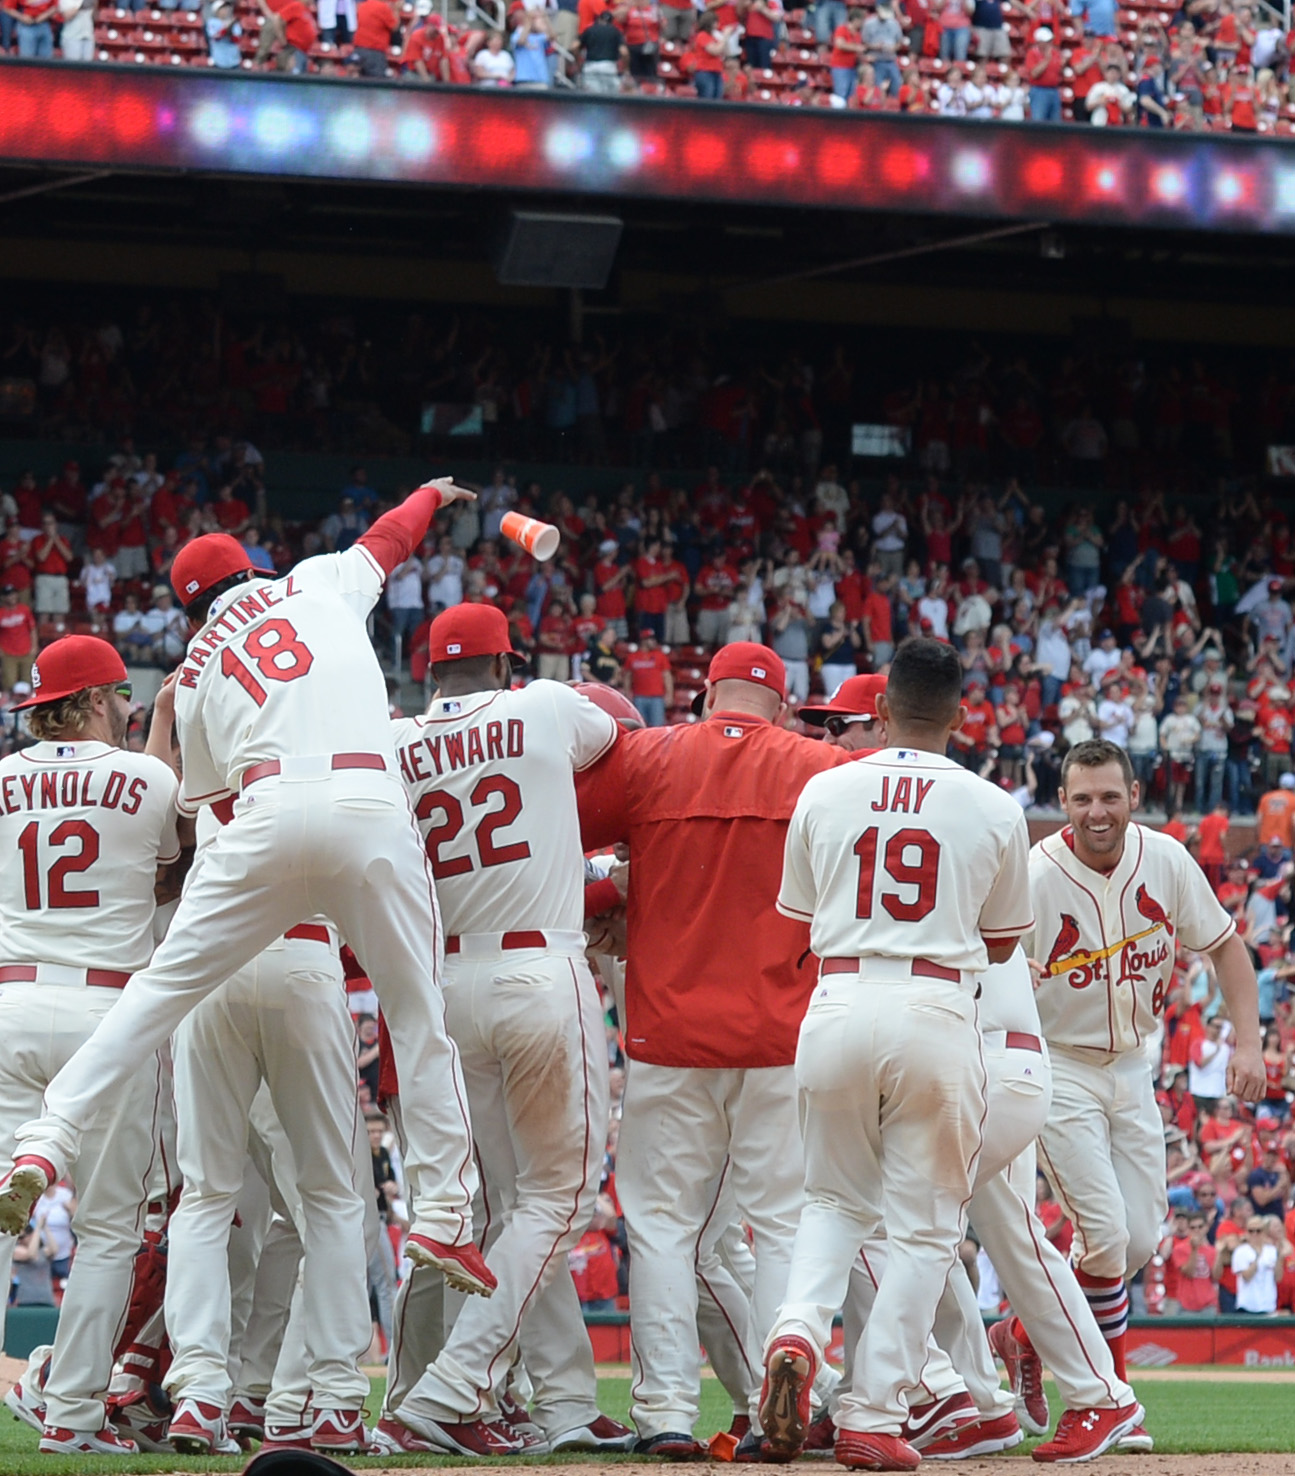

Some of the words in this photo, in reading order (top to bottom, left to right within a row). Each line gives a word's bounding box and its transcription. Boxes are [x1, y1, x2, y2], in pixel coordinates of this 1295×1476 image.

[179, 576, 302, 690] MARTINEZ
[221, 618, 314, 708] 18
[414, 773, 532, 881] 22
[871, 776, 936, 814] JAY
[18, 819, 100, 910] 12
[853, 826, 941, 922] 19
[1116, 939, 1168, 987] Louis
